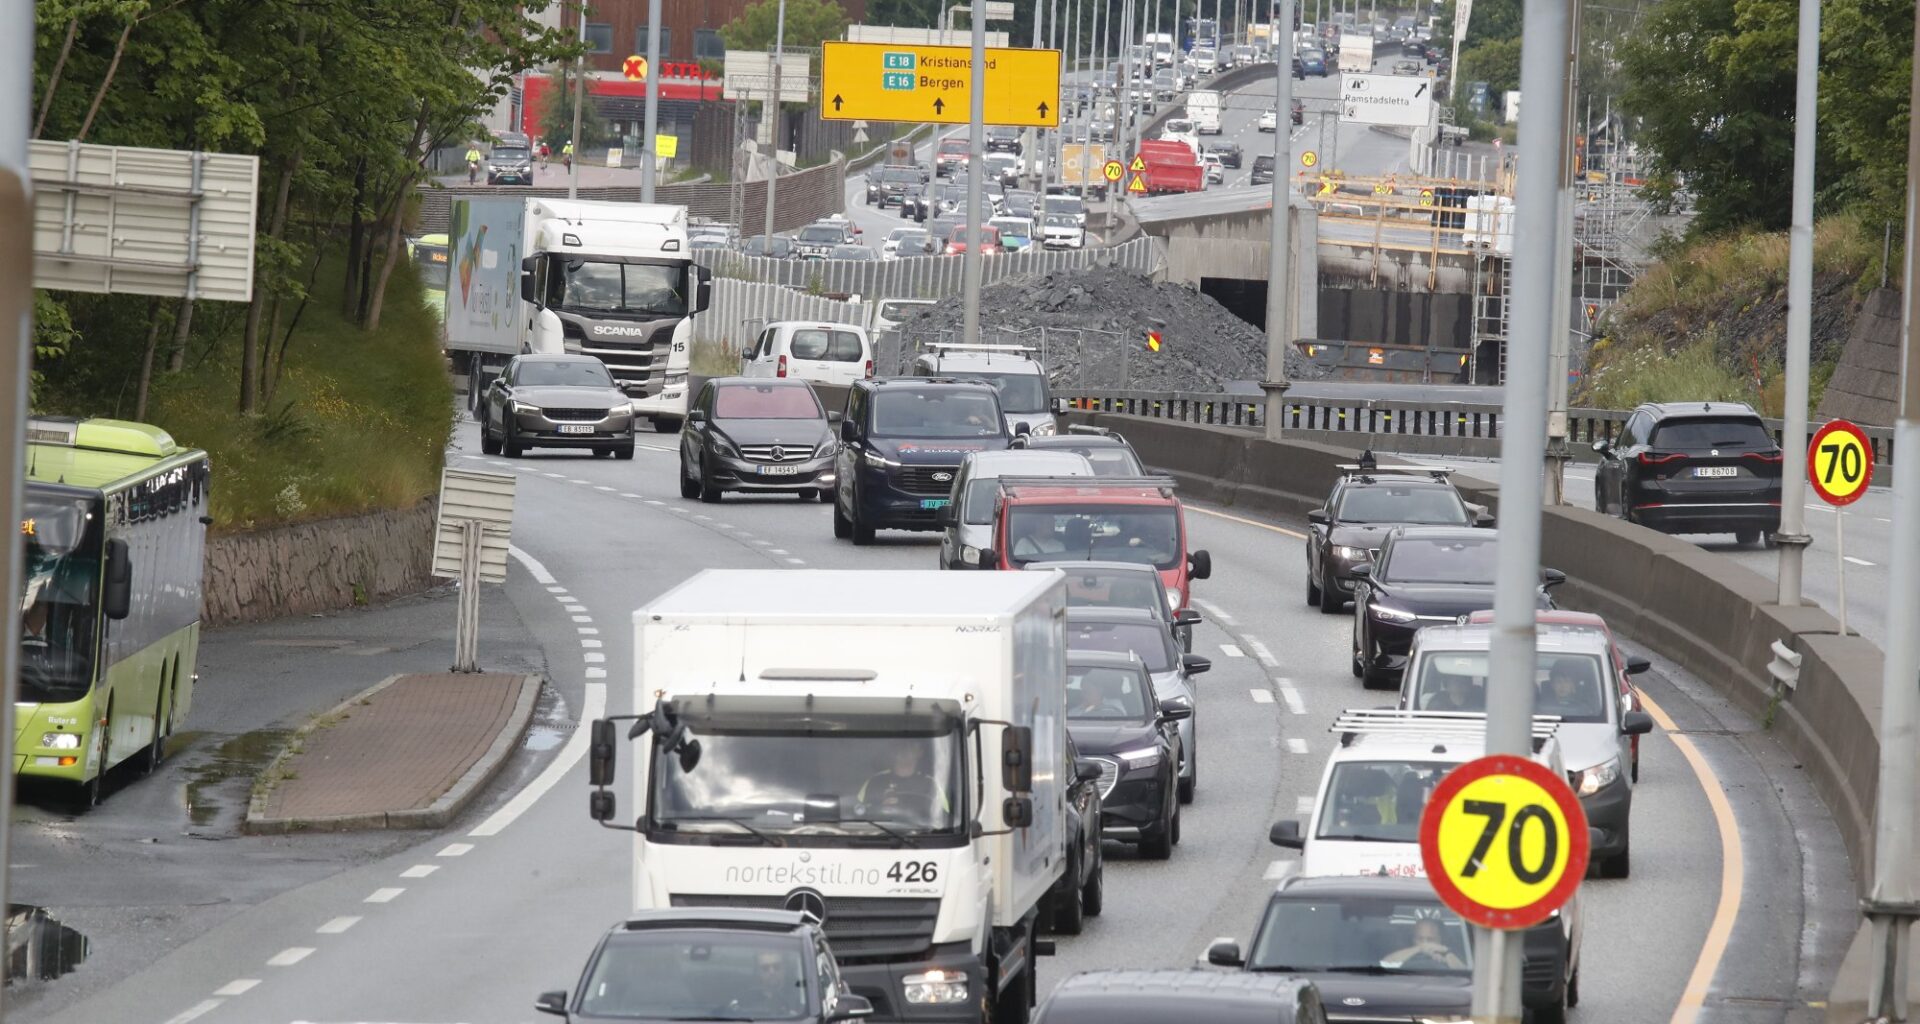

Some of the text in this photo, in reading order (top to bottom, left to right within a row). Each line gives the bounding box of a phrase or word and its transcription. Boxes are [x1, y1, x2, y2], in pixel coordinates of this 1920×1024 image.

[889, 55, 996, 70] E 18 Kristiansnd
[888, 76, 964, 90] E 16 Bergen
[1345, 94, 1410, 106] Ramstadsletta
[1108, 165, 1121, 177] 70
[593, 325, 643, 337] SCANIA
[672, 342, 685, 353] 15
[1821, 442, 1862, 484] 70
[1699, 467, 1708, 476] EF
[1460, 798, 1559, 886] 70
[726, 861, 938, 885] nortekstil.no 426
